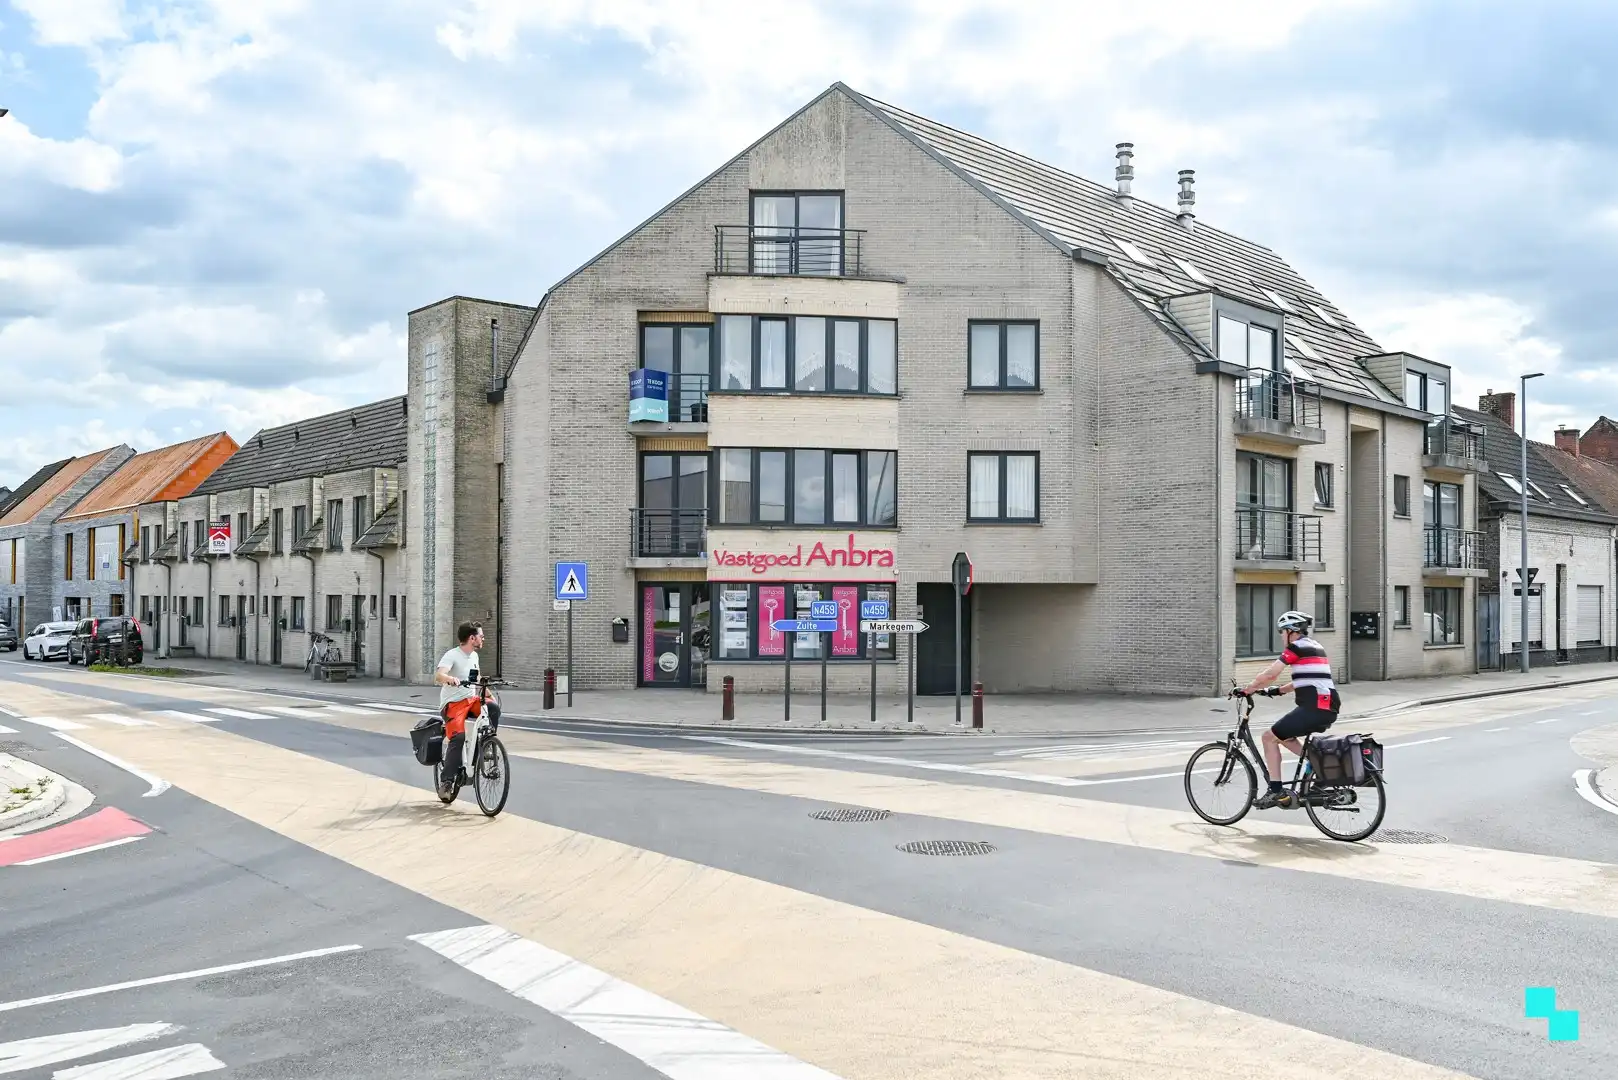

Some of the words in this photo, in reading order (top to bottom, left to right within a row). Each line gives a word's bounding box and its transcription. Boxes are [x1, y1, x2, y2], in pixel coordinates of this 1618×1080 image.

[714, 545, 800, 574] Vastgoed
[806, 534, 894, 567] Anbra
[814, 604, 835, 615] N459
[864, 604, 885, 615] N459
[796, 621, 818, 630] Zulte
[869, 622, 914, 632] Markegem
